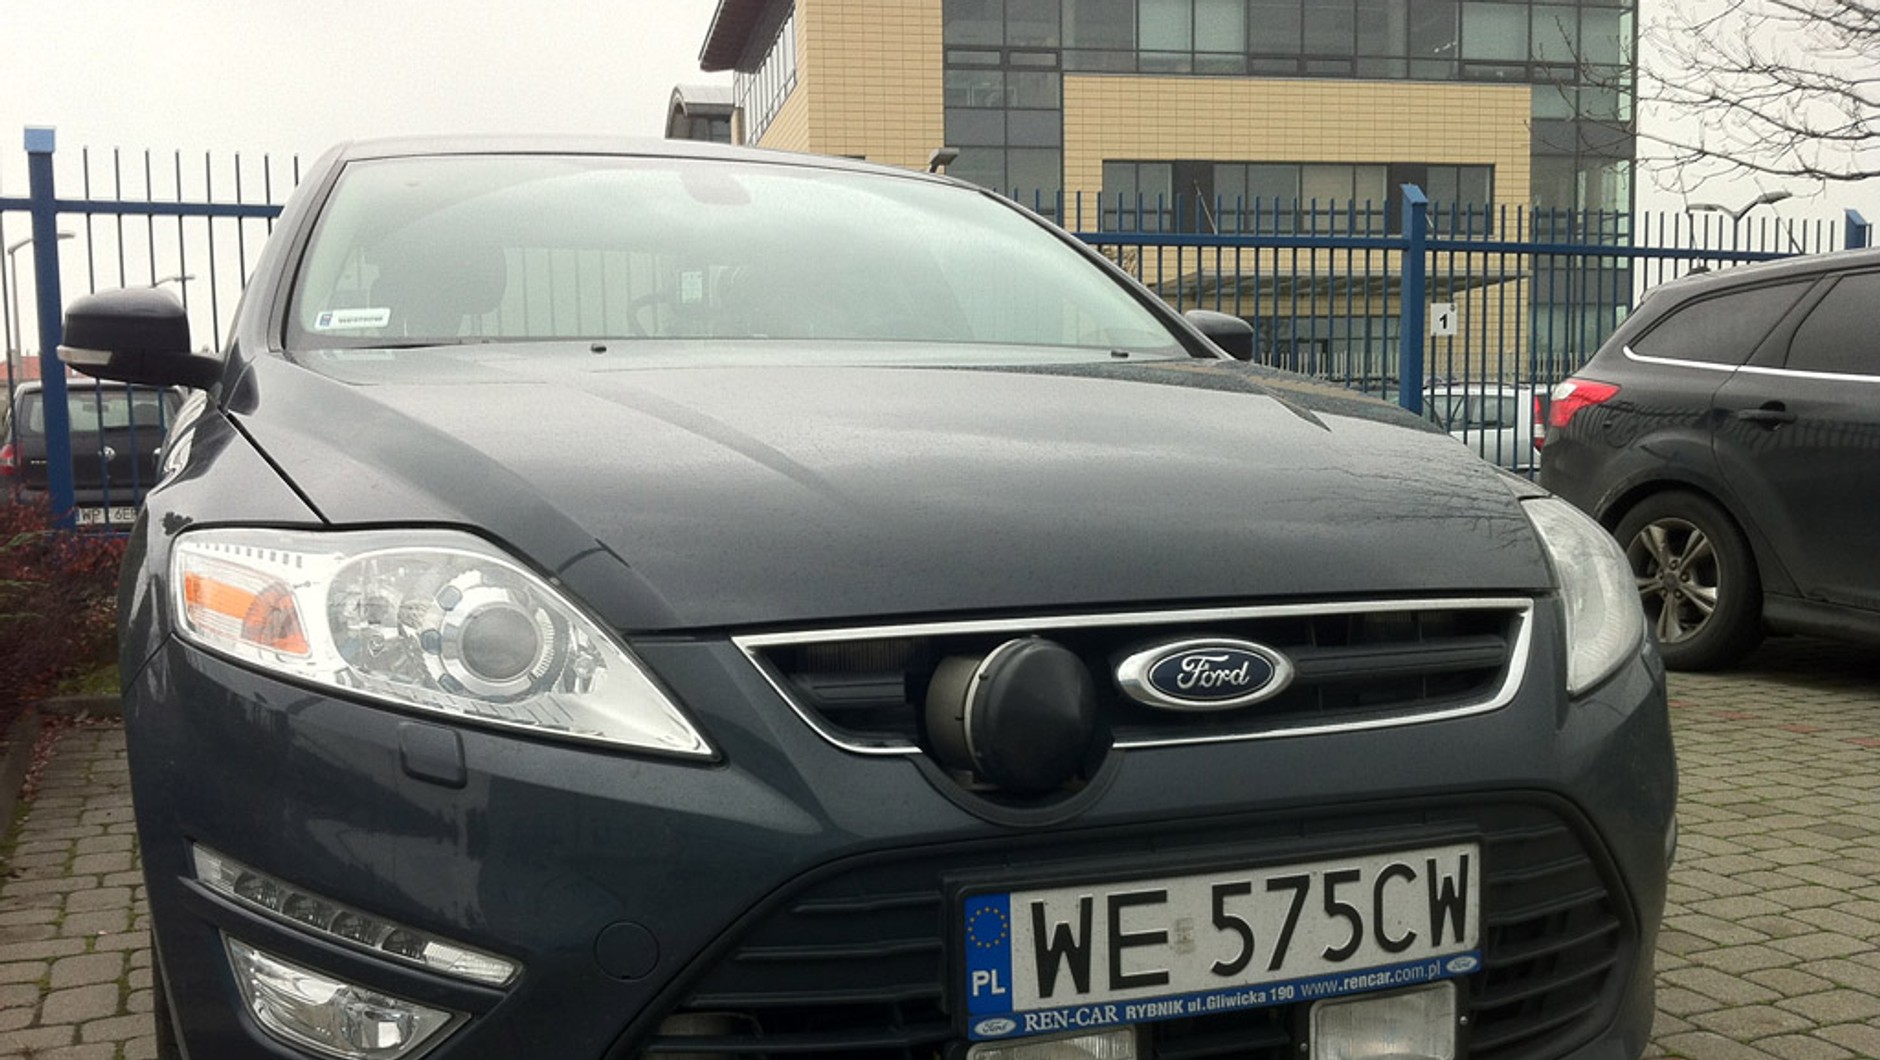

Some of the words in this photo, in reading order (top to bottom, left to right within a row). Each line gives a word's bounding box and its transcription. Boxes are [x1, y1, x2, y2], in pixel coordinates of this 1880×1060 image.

[1439, 313, 1448, 330] 1
[1177, 654, 1250, 690] Ford
[1031, 888, 1170, 999] WE
[1210, 853, 1470, 978] 575CW
[971, 969, 1006, 997] PL
[1024, 1004, 1119, 1032] REN-CAR
[1126, 999, 1184, 1020] RYBNIK
[1269, 985, 1295, 1001] 190
[1301, 961, 1441, 997] www.rencar.com.pl
